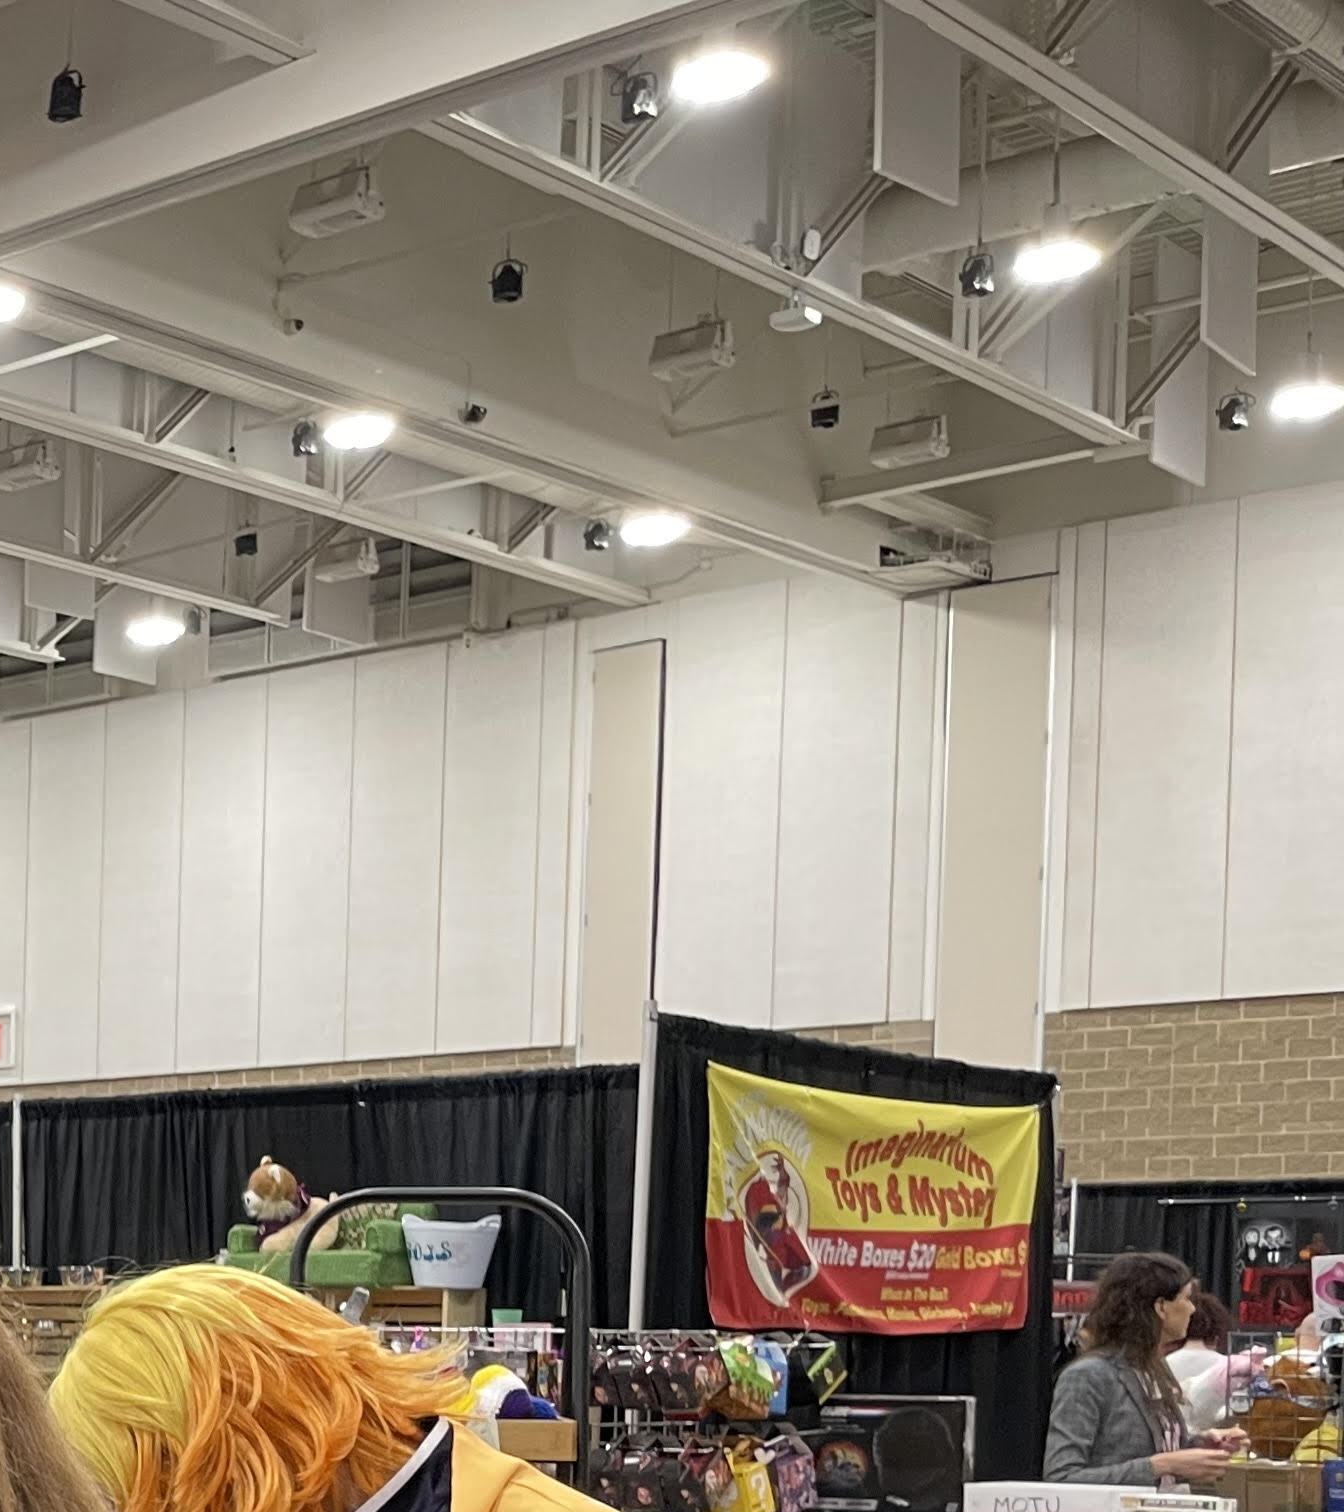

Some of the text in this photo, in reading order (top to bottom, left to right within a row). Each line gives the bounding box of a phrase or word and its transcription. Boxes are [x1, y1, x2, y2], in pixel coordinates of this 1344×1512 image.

[845, 1120, 994, 1186] Imaginarium
[825, 1166, 883, 1224] Toys
[887, 1172, 907, 1216] &
[808, 1237, 858, 1267] White
[861, 1240, 906, 1269] Boxes
[908, 1239, 937, 1271] $20
